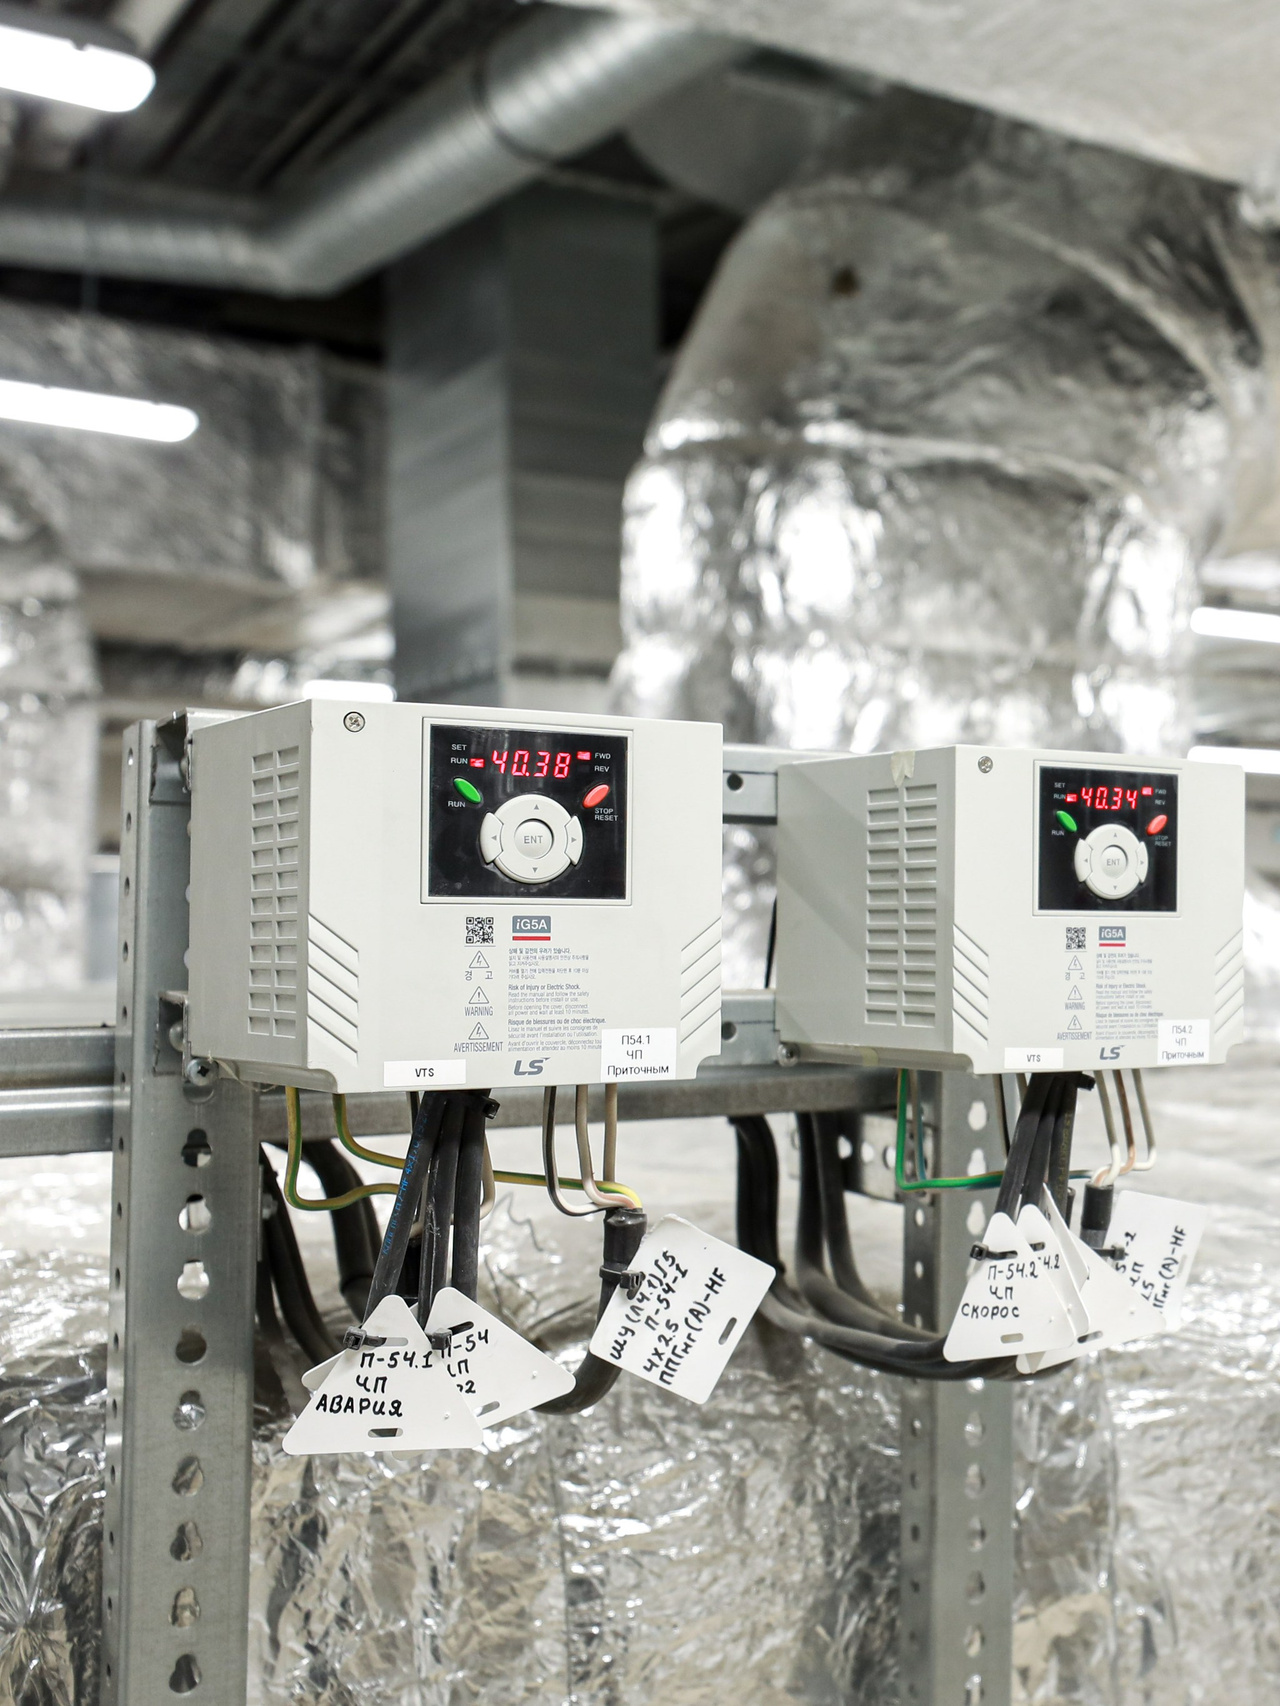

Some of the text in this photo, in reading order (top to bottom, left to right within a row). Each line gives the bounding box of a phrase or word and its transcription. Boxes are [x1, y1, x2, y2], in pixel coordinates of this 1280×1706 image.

[492, 750, 571, 779] 40.38
[1081, 786, 1138, 810] 40.34
[524, 836, 543, 844] ENT
[516, 919, 547, 930] iG5A
[1101, 928, 1124, 938] iG5A
[465, 1006, 493, 1016] WARNING
[1065, 1002, 1085, 1010] WARNING
[1172, 1026, 1192, 1034] П54.2
[621, 1036, 650, 1045] П54.1
[1057, 1032, 1092, 1040] AVERTISSEMENT
[454, 1042, 504, 1052] AVERTISSEMENT
[1175, 1038, 1187, 1046] ЧП
[626, 1050, 643, 1059] ЧП
[1100, 1046, 1122, 1060] LS
[1162, 1052, 1204, 1061] Приточным
[513, 1058, 546, 1076] LS
[607, 1065, 669, 1076] Приточным
[415, 1068, 434, 1077] VTS
[988, 1262, 1039, 1280] П-54.2
[989, 1286, 1013, 1300] ЧП
[961, 1303, 1020, 1319] СКОРОС
[360, 1351, 432, 1369] П-54.1
[356, 1375, 387, 1393] ЧП
[315, 1394, 403, 1417] АВАРИЯ
